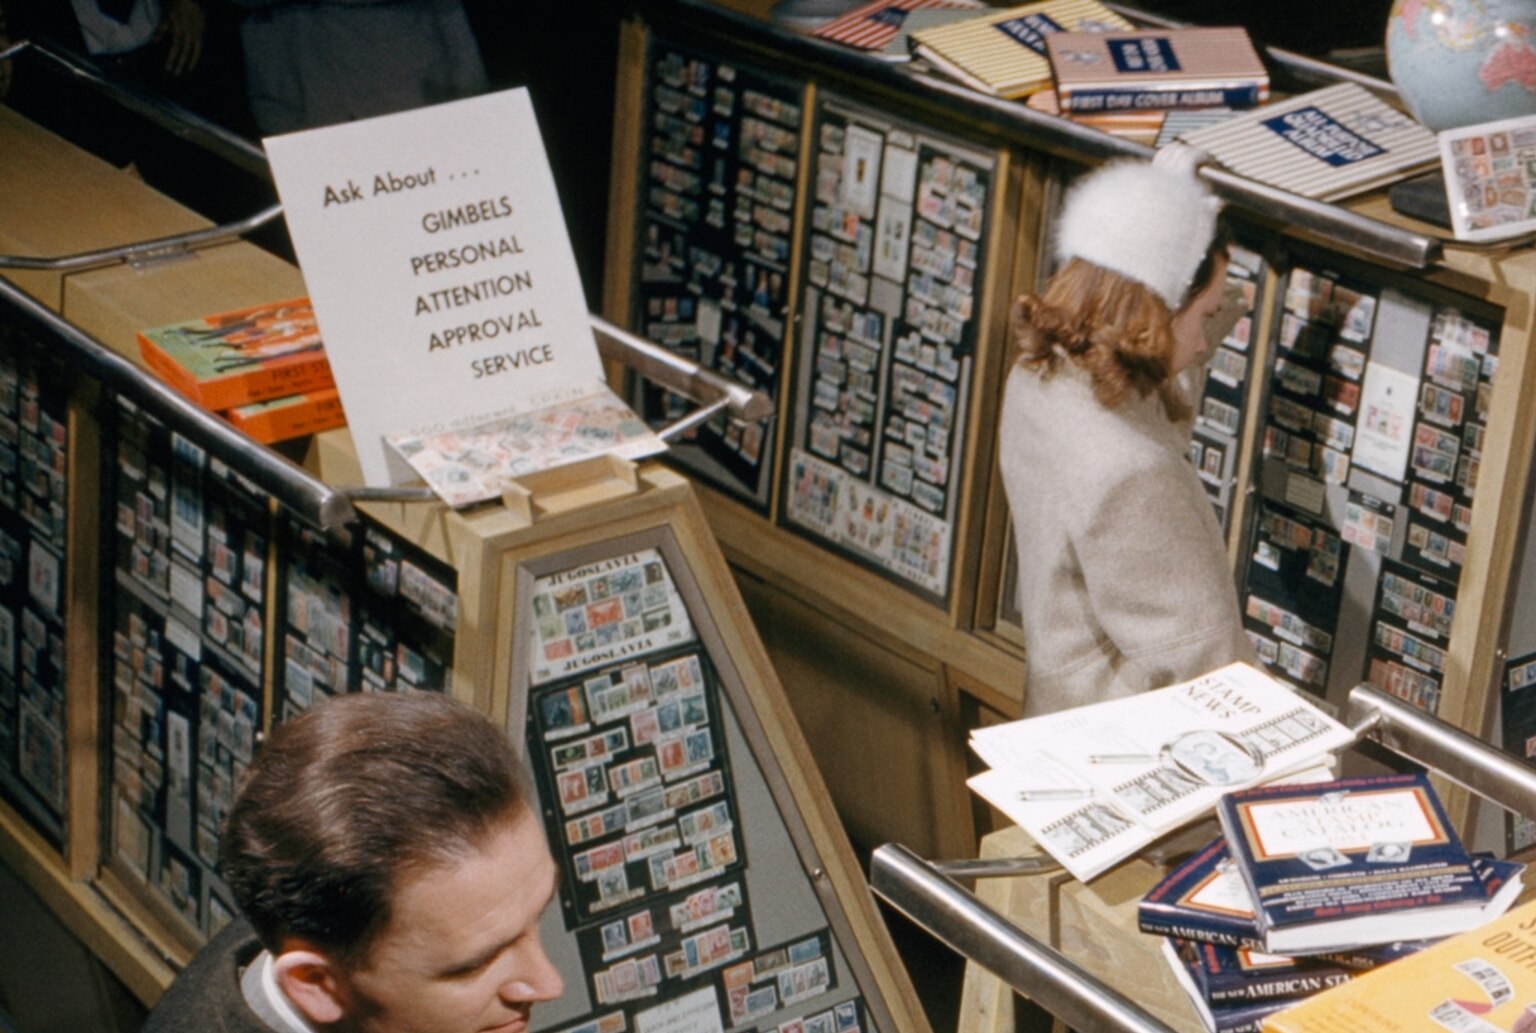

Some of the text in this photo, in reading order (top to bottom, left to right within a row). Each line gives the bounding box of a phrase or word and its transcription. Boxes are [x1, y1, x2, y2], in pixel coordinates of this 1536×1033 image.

[1070, 91, 1223, 110] FIRST DAY COVER ALBUM
[323, 167, 436, 208] Ask About
[422, 196, 514, 234] GIMBELS
[410, 236, 524, 276] PERSONAL
[415, 271, 533, 316] ATTENTION
[428, 308, 542, 352] APPROVAL
[471, 344, 554, 379] SERVICE
[549, 553, 640, 587] JUGOSLAVIA
[563, 638, 653, 672] JUGOSLAVIA
[1187, 686, 1236, 718] NEWS
[1200, 678, 1262, 714] STAMP
[1302, 812, 1379, 827] STAMP
[1155, 921, 1239, 948] NEW AMERICAN
[1227, 988, 1246, 999] NEW
[1246, 976, 1322, 999] AMERICAN
